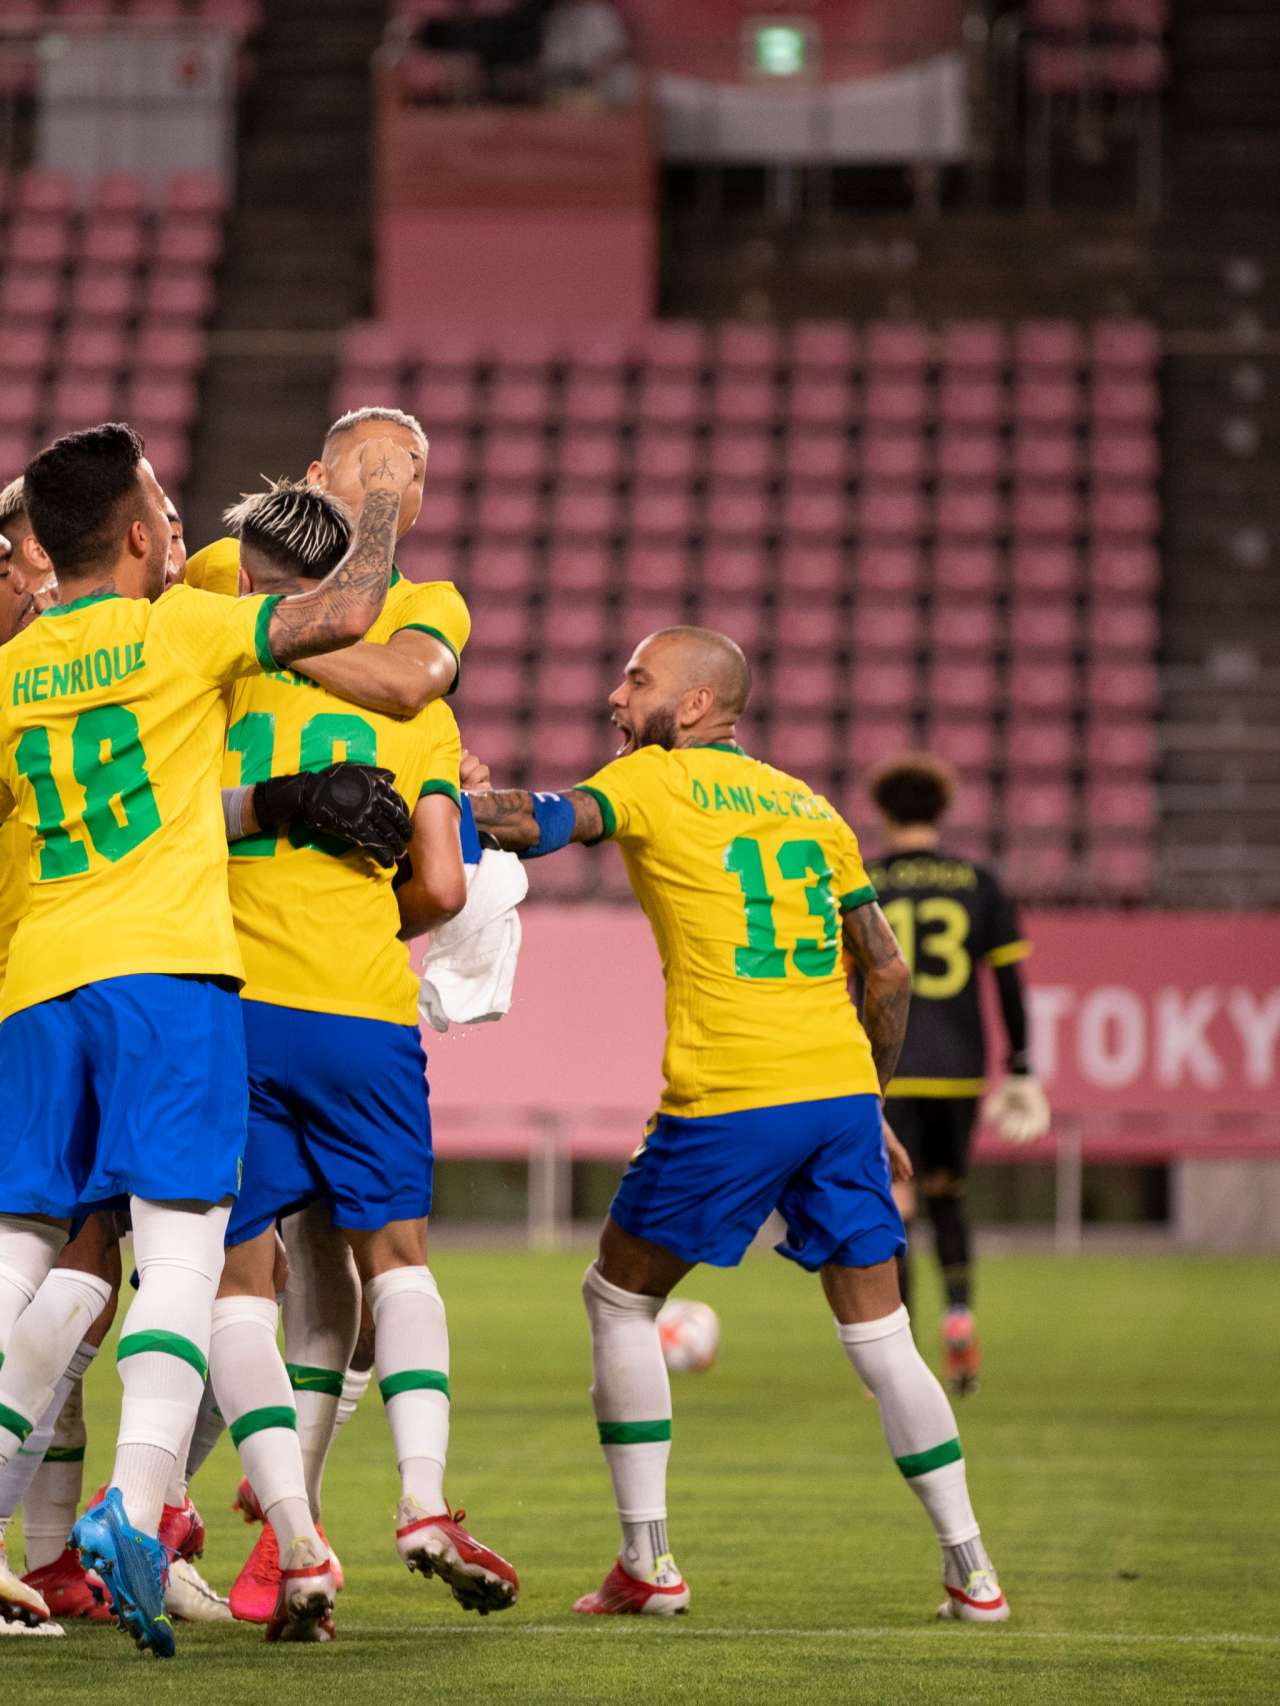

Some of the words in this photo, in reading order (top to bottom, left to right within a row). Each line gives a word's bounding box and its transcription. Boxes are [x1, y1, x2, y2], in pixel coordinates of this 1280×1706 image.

[12, 641, 147, 706] HENRIQUE
[14, 703, 163, 881] 18
[692, 779, 757, 817] DANI
[723, 836, 839, 978] 13
[880, 896, 971, 1000] 13
